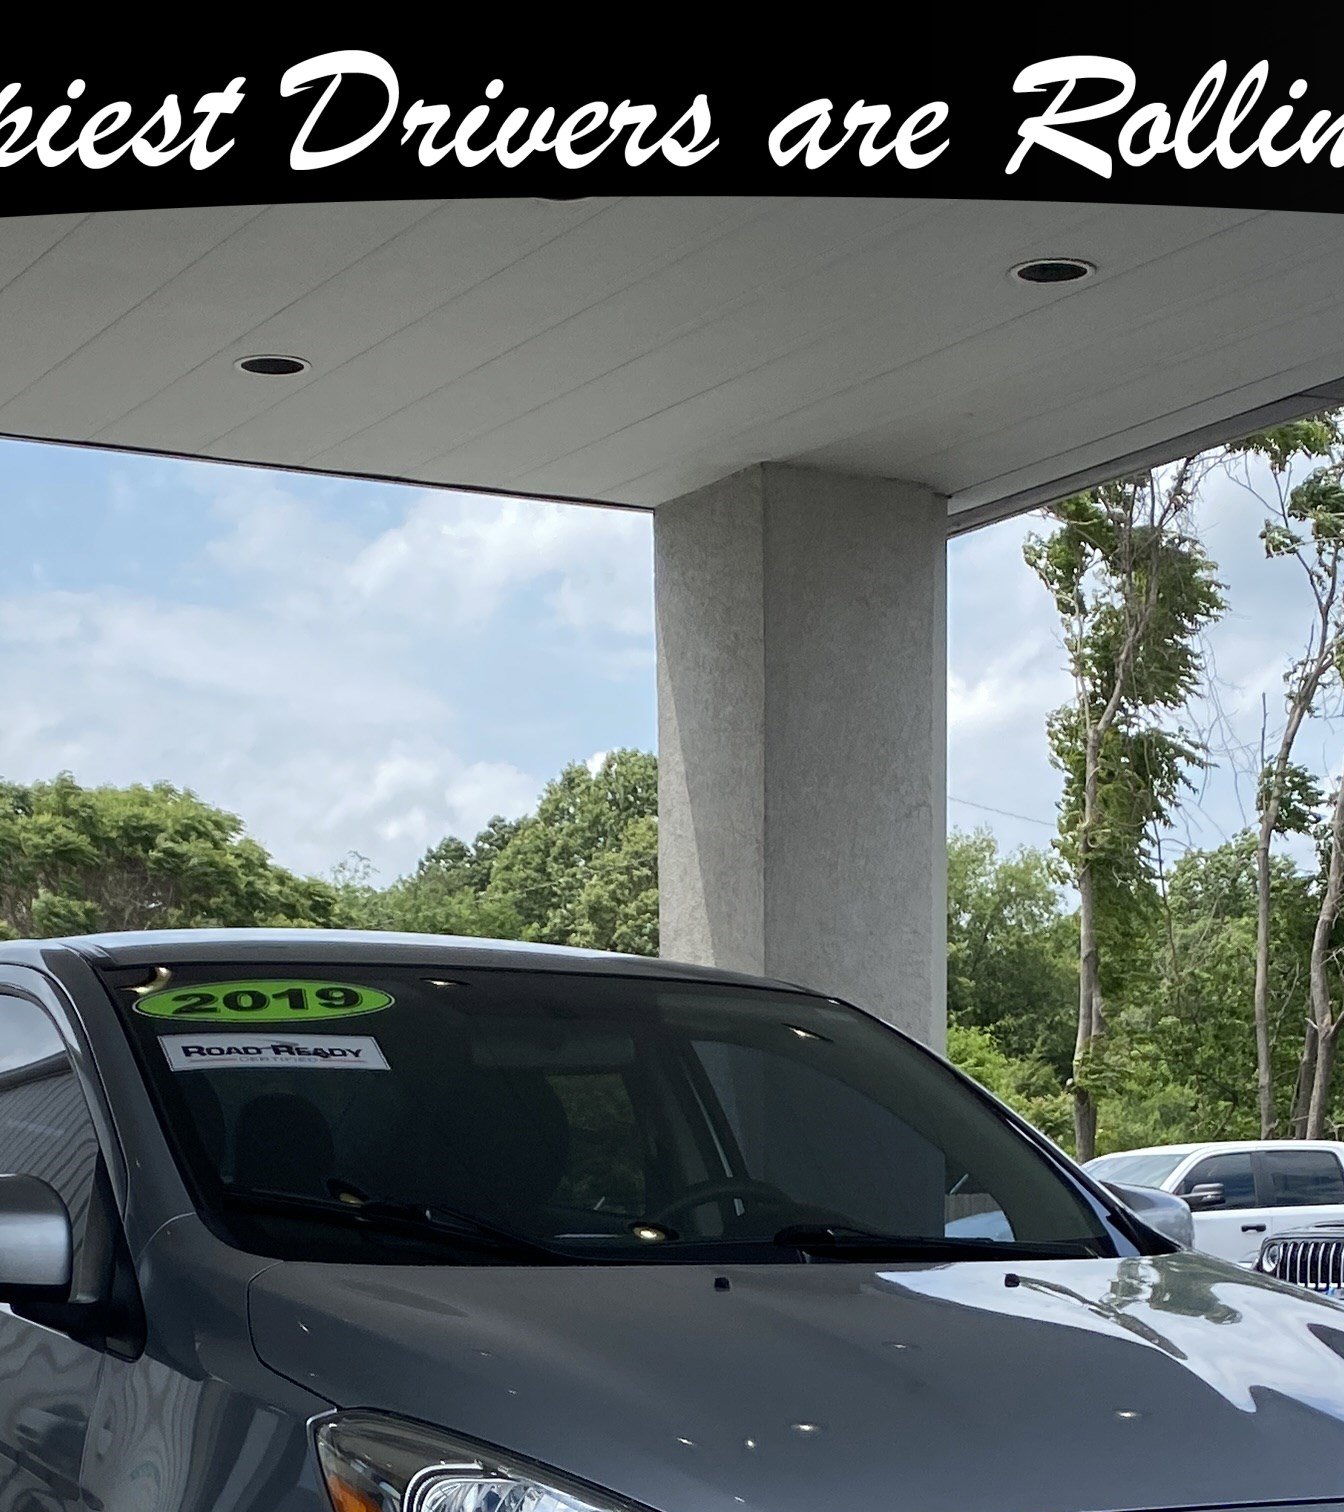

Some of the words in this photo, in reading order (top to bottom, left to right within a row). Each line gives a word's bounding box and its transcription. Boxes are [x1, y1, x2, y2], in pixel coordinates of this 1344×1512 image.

[171, 985, 364, 1015] 2019
[181, 1044, 262, 1058] ROAD
[271, 1043, 363, 1060] READY
